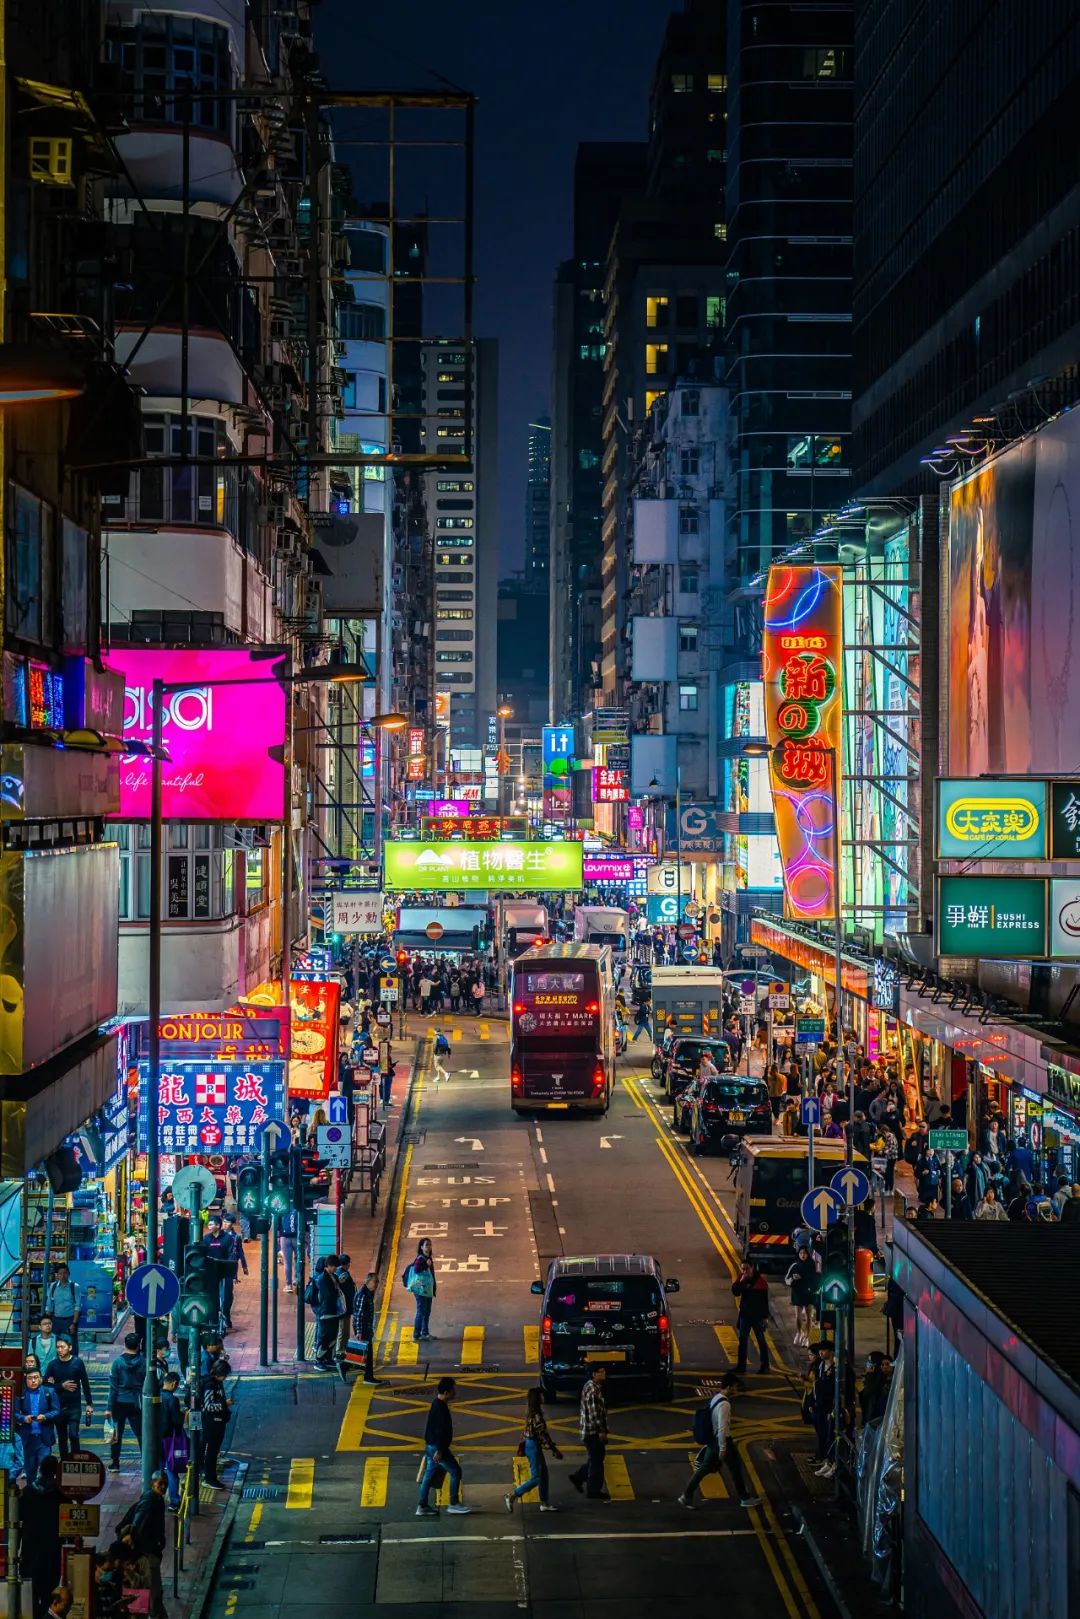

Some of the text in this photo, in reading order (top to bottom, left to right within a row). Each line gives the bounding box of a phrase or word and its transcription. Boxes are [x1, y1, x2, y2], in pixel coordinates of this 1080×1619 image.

[551, 734, 568, 751] i.t
[126, 772, 148, 791] life
[459, 850, 546, 871] 植物醫生
[997, 913, 1026, 921] SUSHI
[997, 921, 1040, 929] EXPRESS
[159, 1023, 243, 1042] ONJOUR
[416, 1176, 496, 1186] BUS
[405, 1197, 511, 1208] STOP
[407, 1221, 508, 1238] 巴士
[71, 1510, 86, 1519] 905
